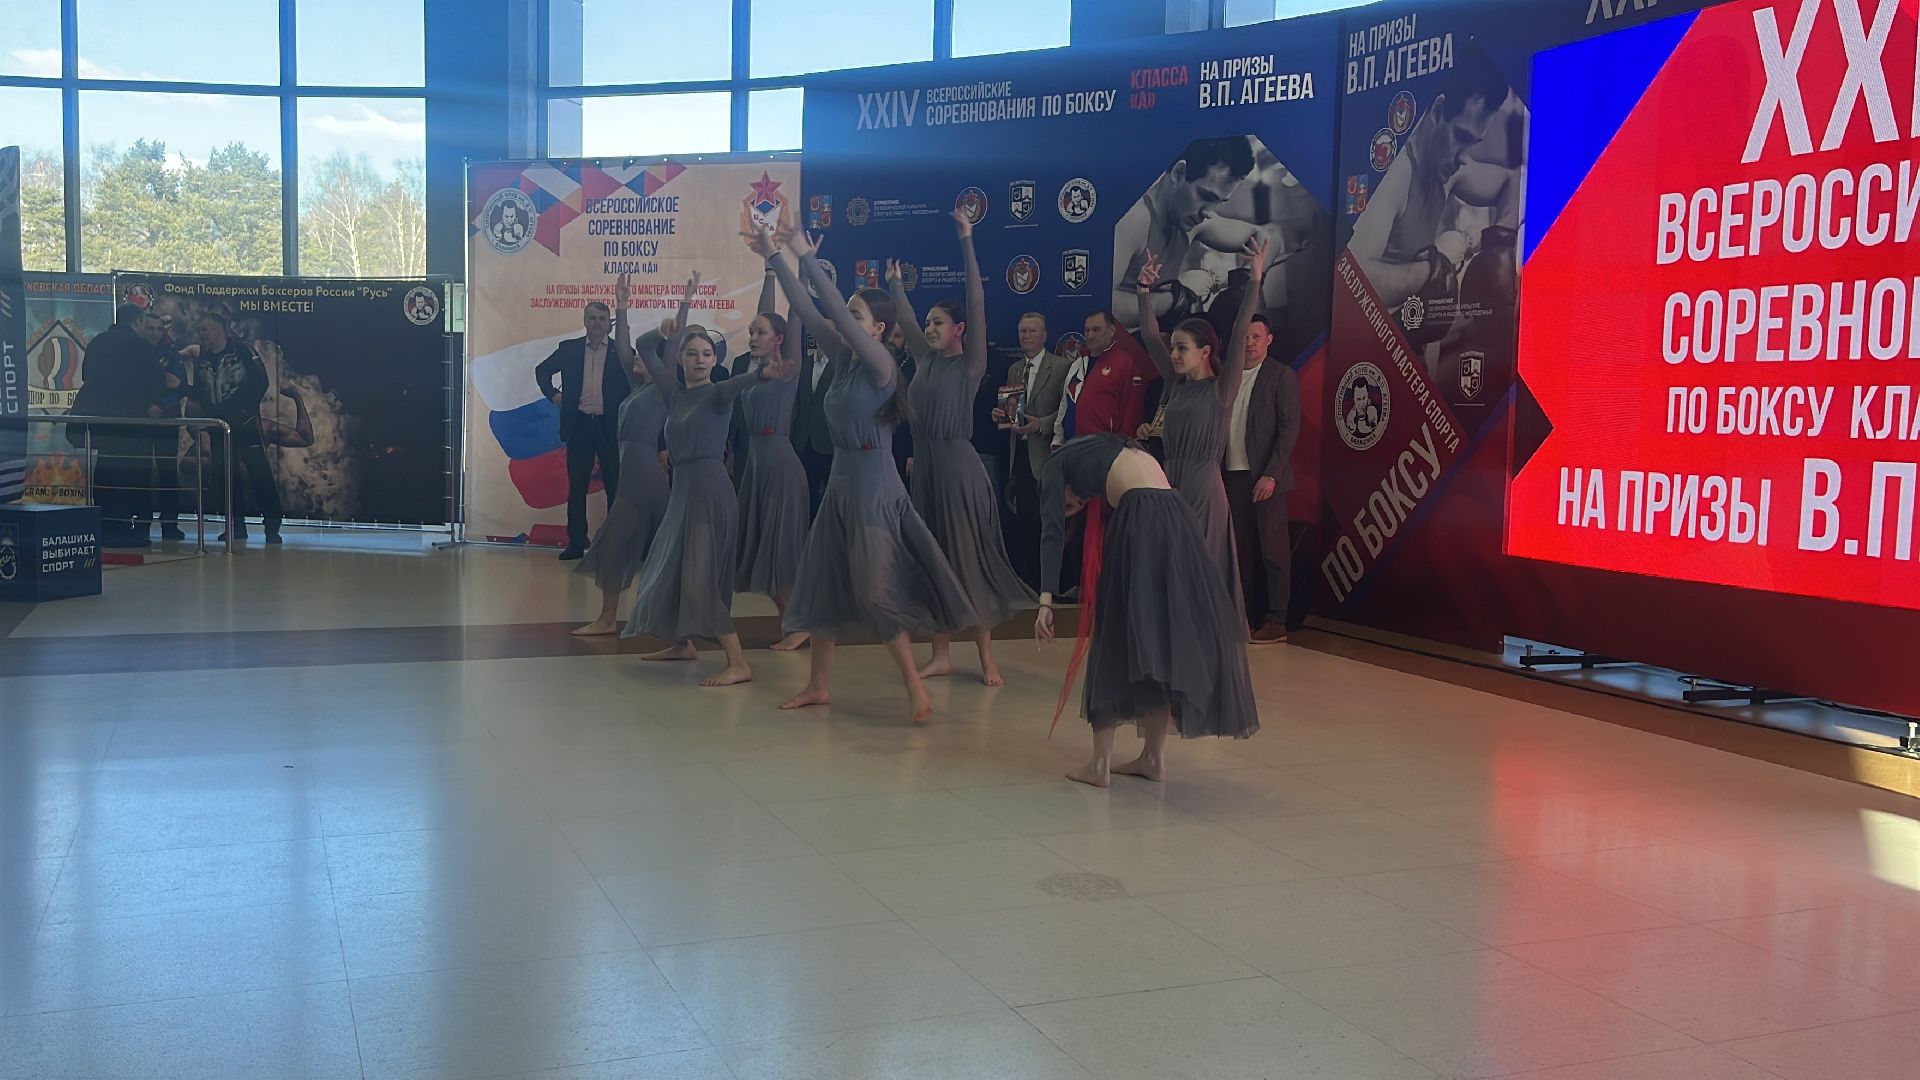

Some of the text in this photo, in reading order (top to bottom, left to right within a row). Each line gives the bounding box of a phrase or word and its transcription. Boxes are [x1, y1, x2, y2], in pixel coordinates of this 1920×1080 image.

[1349, 13, 1417, 58] НА ПРИЗЫ
[1200, 54, 1274, 81] НА ПРИЗЫ
[1346, 32, 1454, 95] В.П. АГЕЕВА
[1130, 64, 1189, 89] КЛАССА
[926, 81, 1012, 104] ВСЕРОССИЙСКИЕ
[1200, 72, 1314, 109] В.П. АГЕЕВА
[856, 89, 920, 130] XXIV
[926, 89, 1117, 126] СОРЕВНОВАНИЯ ПО БОКСУ
[588, 218, 676, 236] СОРЕВНОВАНИЕ
[603, 240, 659, 257] ПО БОКСУ
[603, 261, 640, 274] КЛАССА
[164, 283, 195, 295] Фонд
[197, 284, 259, 297] Поддержки
[261, 285, 313, 299] Боксеров
[315, 286, 355, 297] России
[556, 284, 580, 295] ПРИЗЫ
[637, 284, 670, 295] МАСТЕРА
[240, 300, 314, 312] МЫ ВМЕСТЕ!
[635, 298, 667, 309] ВИКТОРА
[708, 299, 735, 310] АГЕЕВА
[1338, 257, 1460, 454] ЗАСЛУЖЕННОГО МАСТЕРА СПОРТА
[3, 341, 19, 414] СПОРТ
[49, 392, 60, 405] ПО
[1666, 386, 1708, 434] ПО
[1716, 386, 1835, 437] БОКСУ
[1321, 422, 1441, 604] ПО БОКСУ
[1557, 466, 1606, 530] НА
[1617, 470, 1771, 546] ПРИЗЫ
[42, 533, 96, 547] БАЛАШИХА
[42, 545, 96, 560] ВЫБИРАЕТ
[42, 560, 75, 573] СПОРТ
